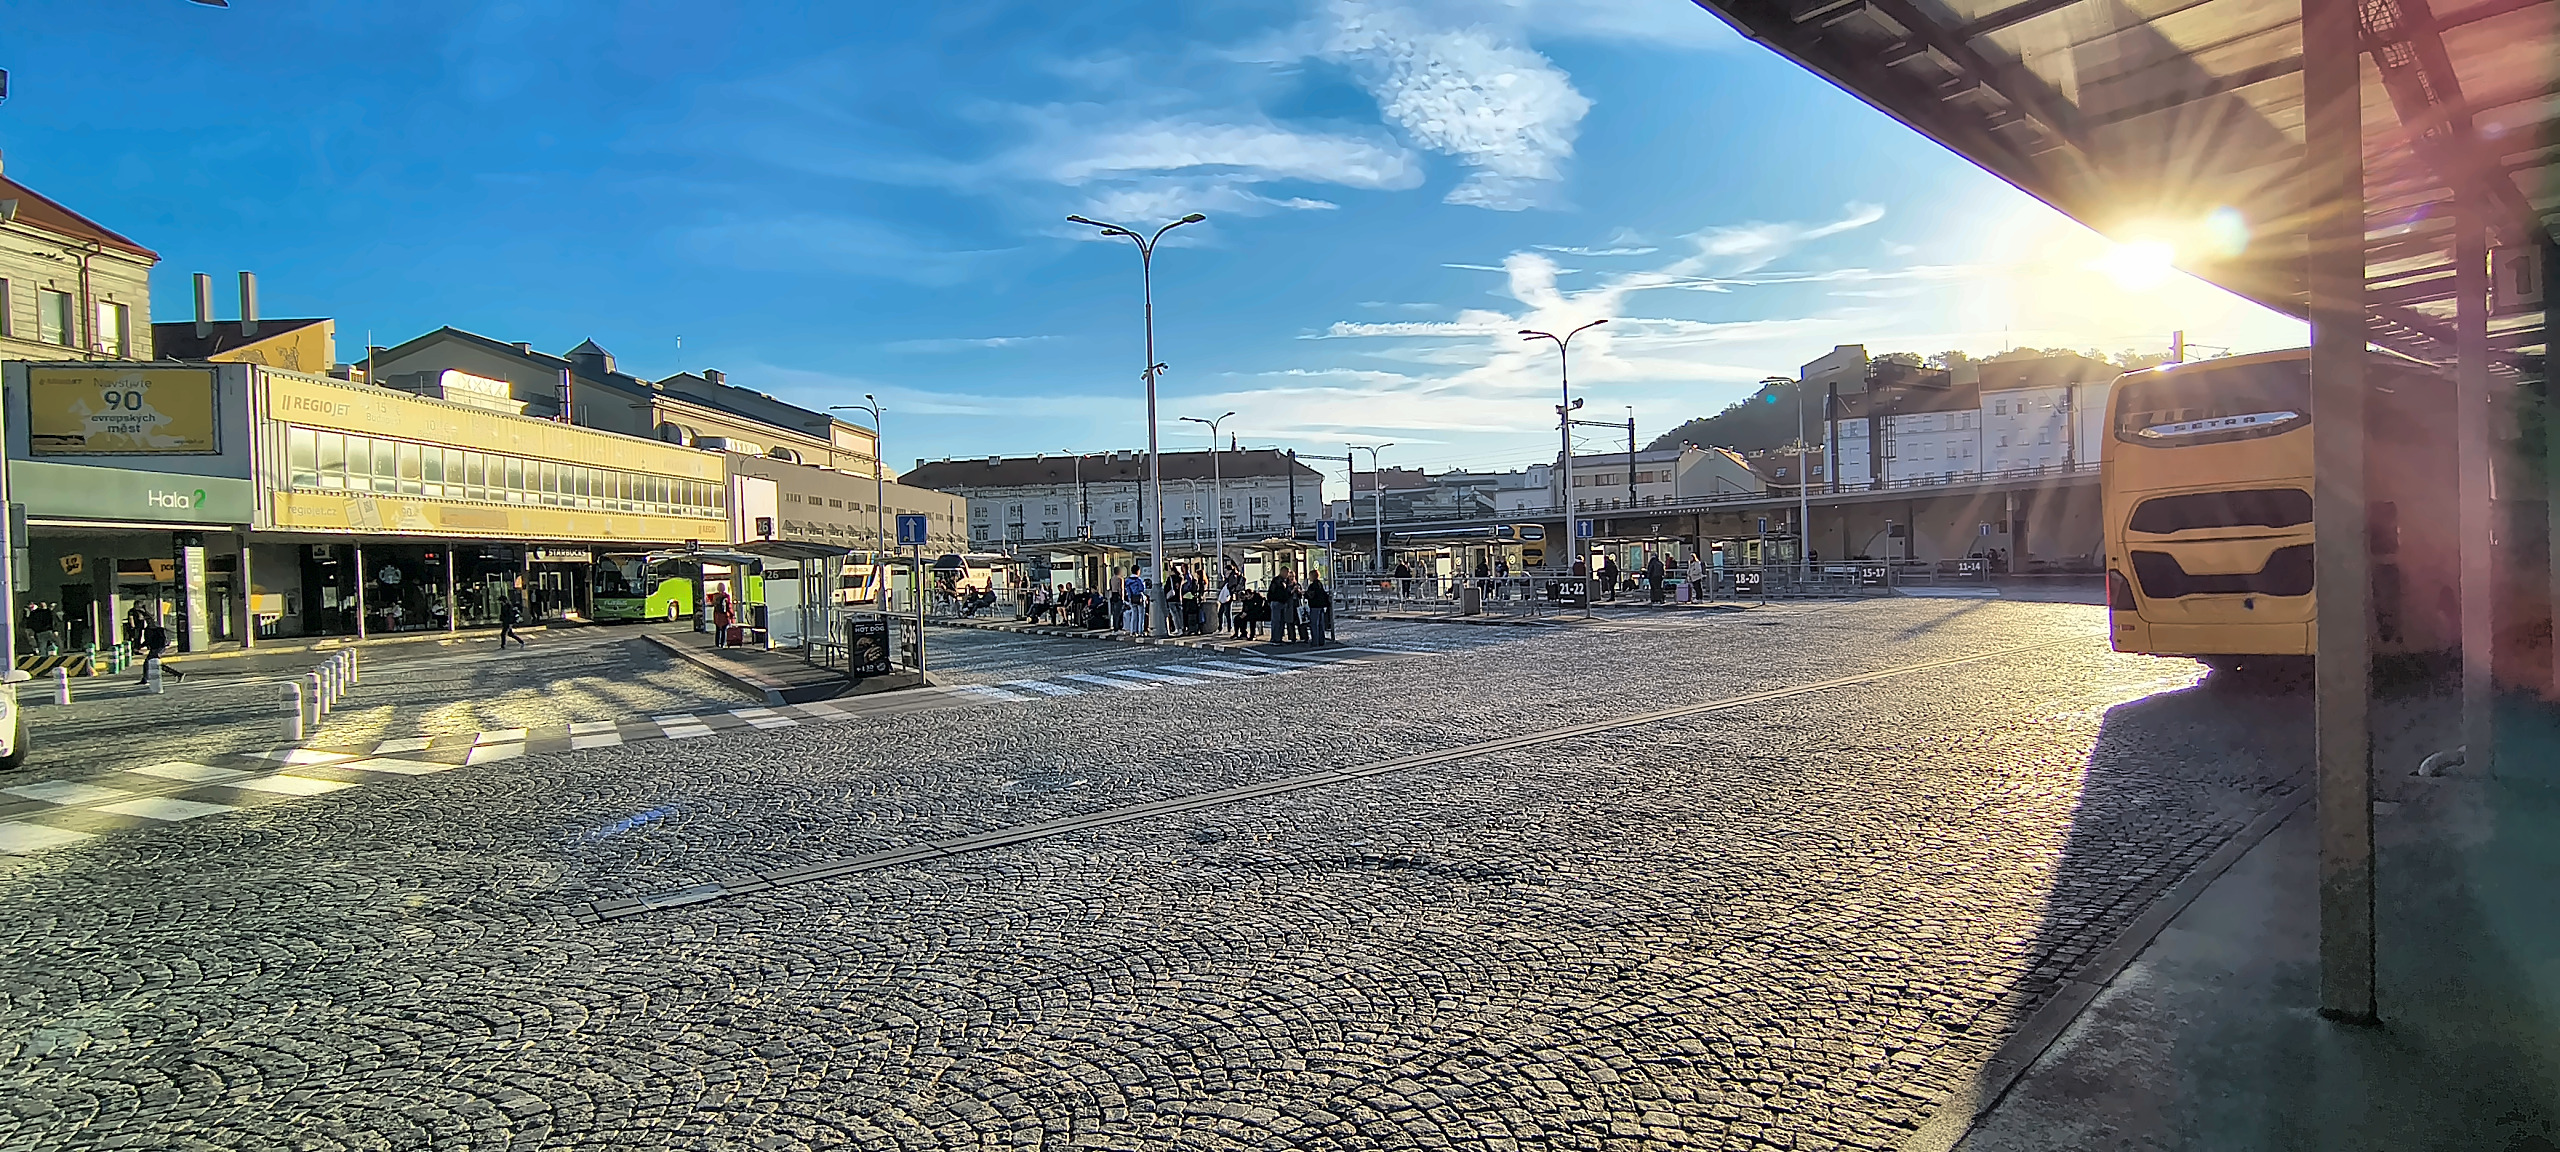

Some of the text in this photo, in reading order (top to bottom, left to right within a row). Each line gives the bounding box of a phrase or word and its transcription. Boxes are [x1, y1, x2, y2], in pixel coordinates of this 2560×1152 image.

[2504, 255, 2533, 295] 1
[104, 391, 142, 411] 90
[293, 396, 351, 417] REGIOJET
[148, 489, 206, 509] Hala 2
[757, 521, 769, 532] 26
[1078, 527, 1088, 537] 24
[686, 541, 696, 550] 25
[548, 548, 587, 557] STARBUCKS
[1958, 562, 1981, 571] 11-14
[766, 570, 779, 579] 26
[1735, 573, 1760, 584] 18-20
[1862, 568, 1886, 578] 15-17
[1559, 582, 1585, 595] 21-22
